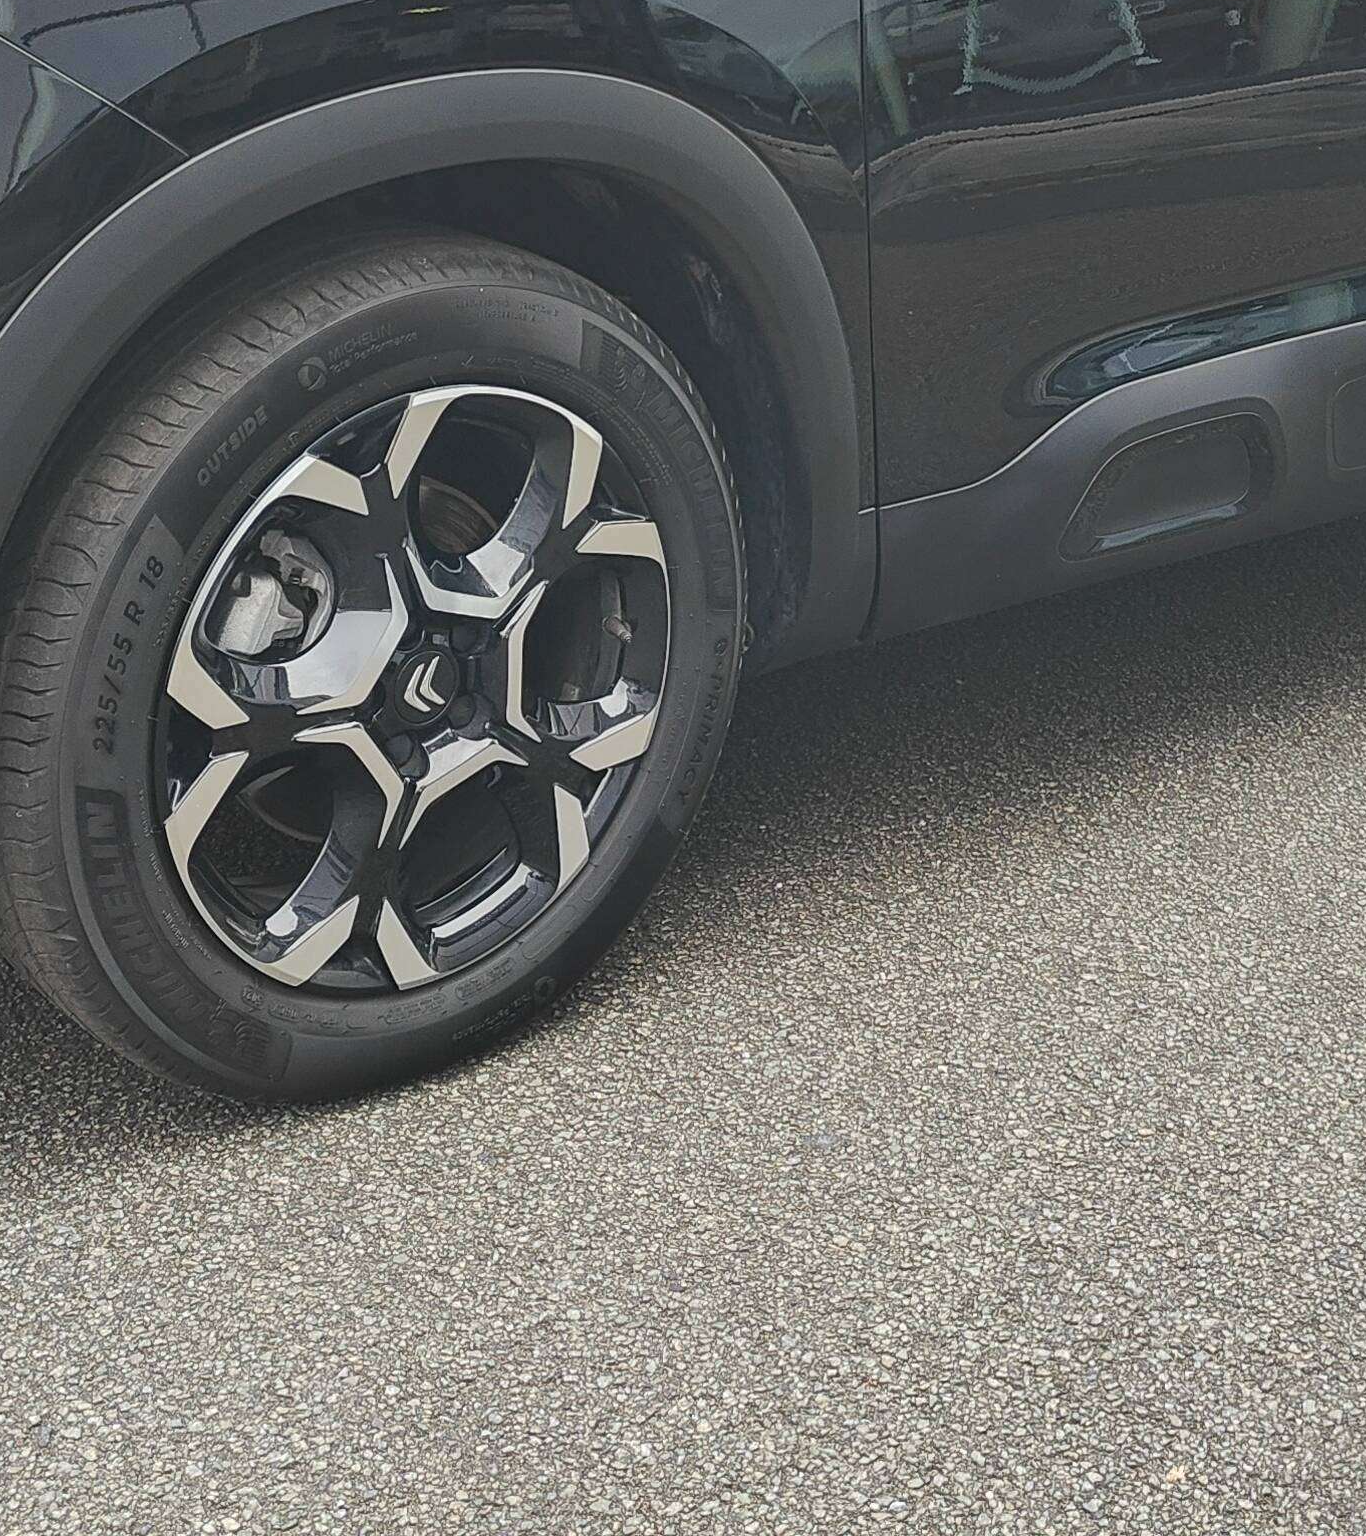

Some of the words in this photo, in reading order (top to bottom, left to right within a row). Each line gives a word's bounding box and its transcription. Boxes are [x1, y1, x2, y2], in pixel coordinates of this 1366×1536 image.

[328, 323, 395, 361] MICHELIN
[196, 404, 269, 486] OUTSIDE
[92, 632, 133, 755] 225/55
[123, 600, 146, 627] R
[138, 555, 164, 591] 18
[86, 800, 197, 1006] MICHELIN
